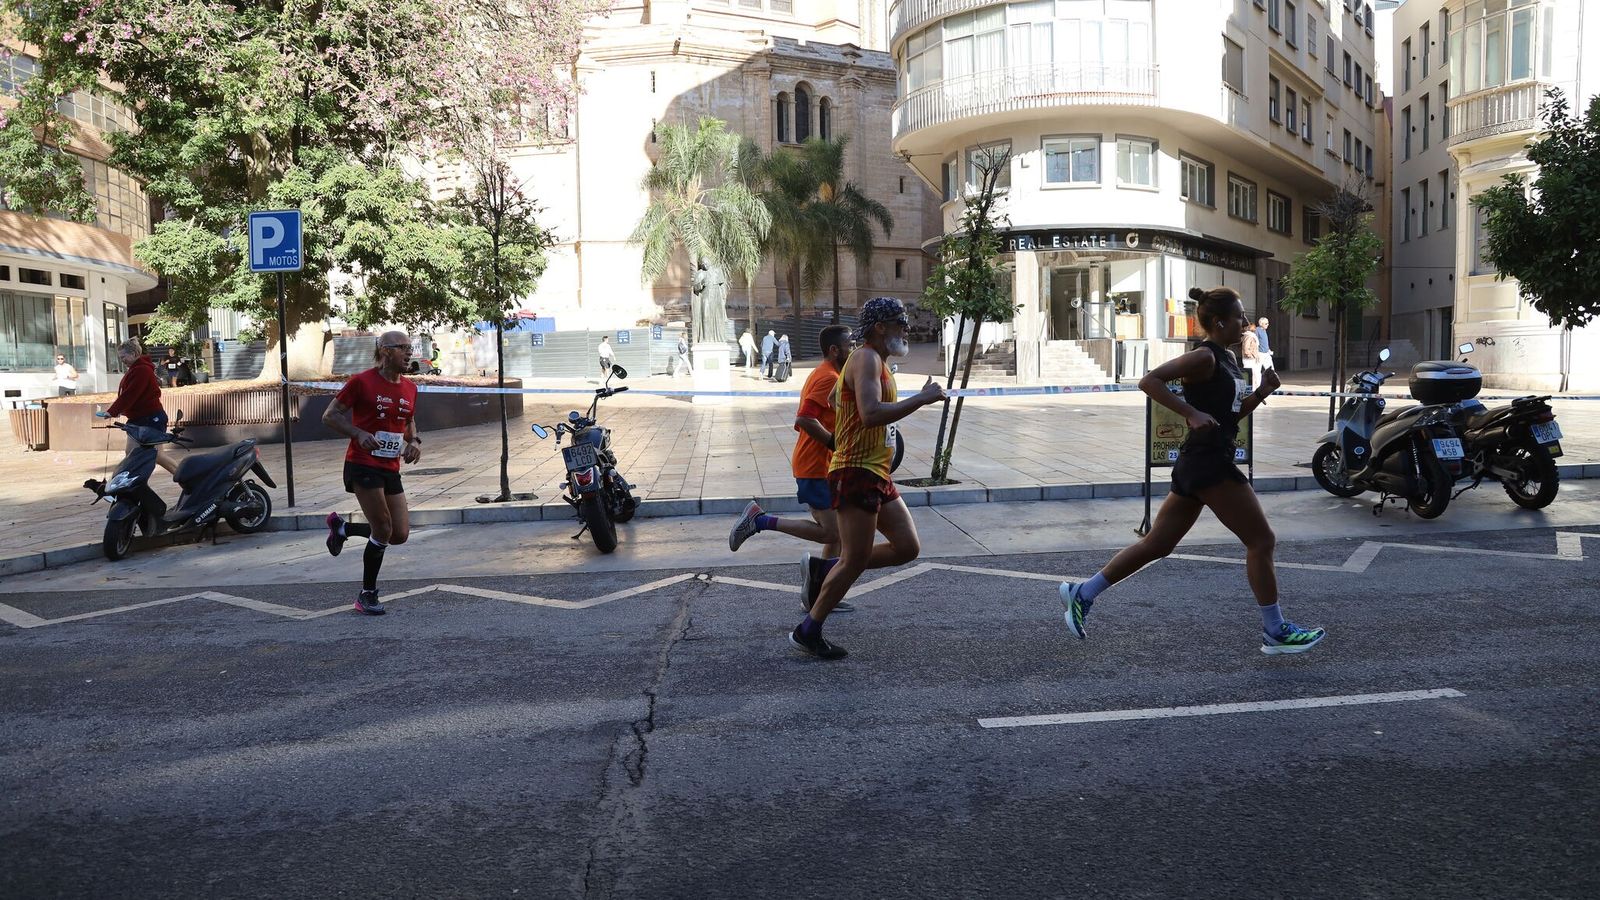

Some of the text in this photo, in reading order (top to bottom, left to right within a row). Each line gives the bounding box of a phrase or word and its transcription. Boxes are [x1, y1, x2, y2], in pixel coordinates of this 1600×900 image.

[252, 216, 285, 265] P
[1009, 237, 1045, 250] REAL
[1052, 235, 1107, 248] ESTATE
[269, 255, 298, 266] MOTOS
[570, 444, 593, 457] 6492
[1169, 452, 1178, 460] 23
